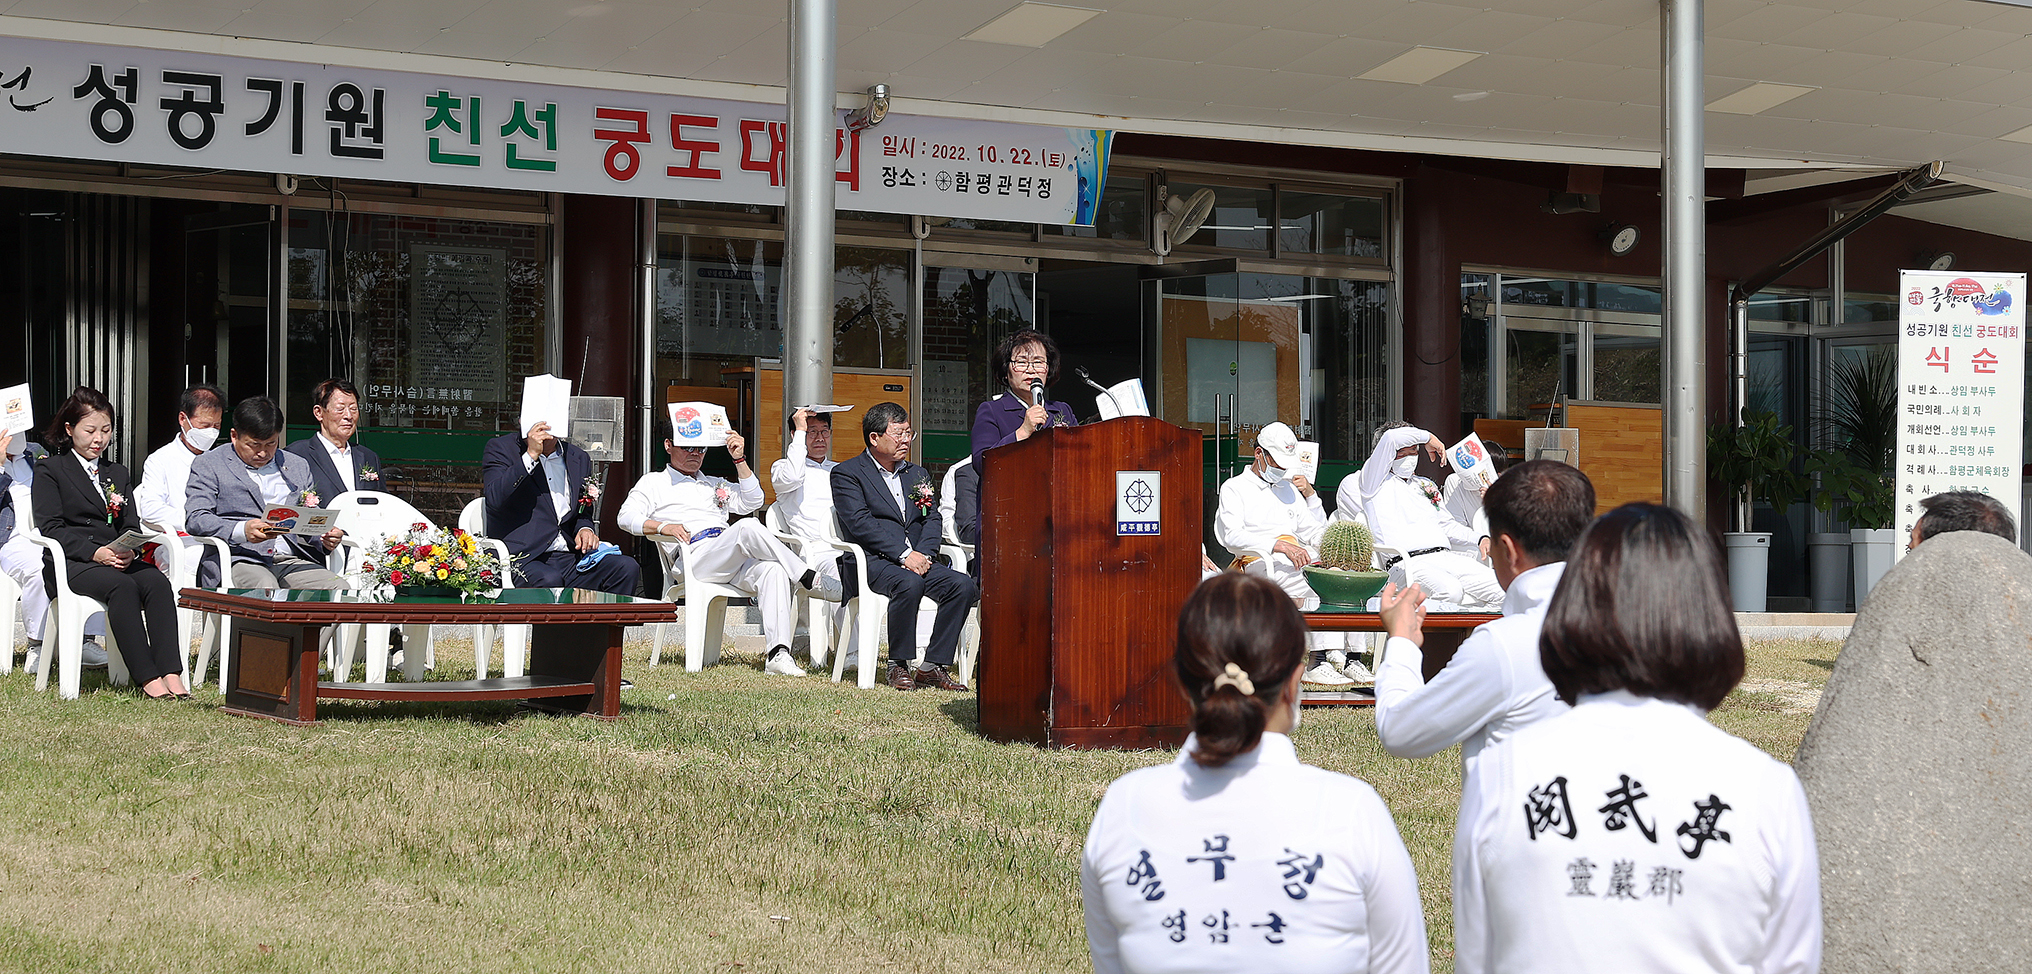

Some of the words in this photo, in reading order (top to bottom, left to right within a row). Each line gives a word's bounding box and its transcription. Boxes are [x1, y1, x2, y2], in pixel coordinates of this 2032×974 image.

[73, 63, 385, 160] 성공기원
[424, 90, 558, 172] 친선
[882, 135, 916, 159] 일시
[931, 144, 970, 162] 2022.
[881, 166, 916, 188] 장소
[1906, 323, 1948, 337] 성공기원
[1952, 324, 1973, 338] 친선
[1976, 325, 2018, 339] 궁도대회
[1161, 908, 1287, 945] 영암군
